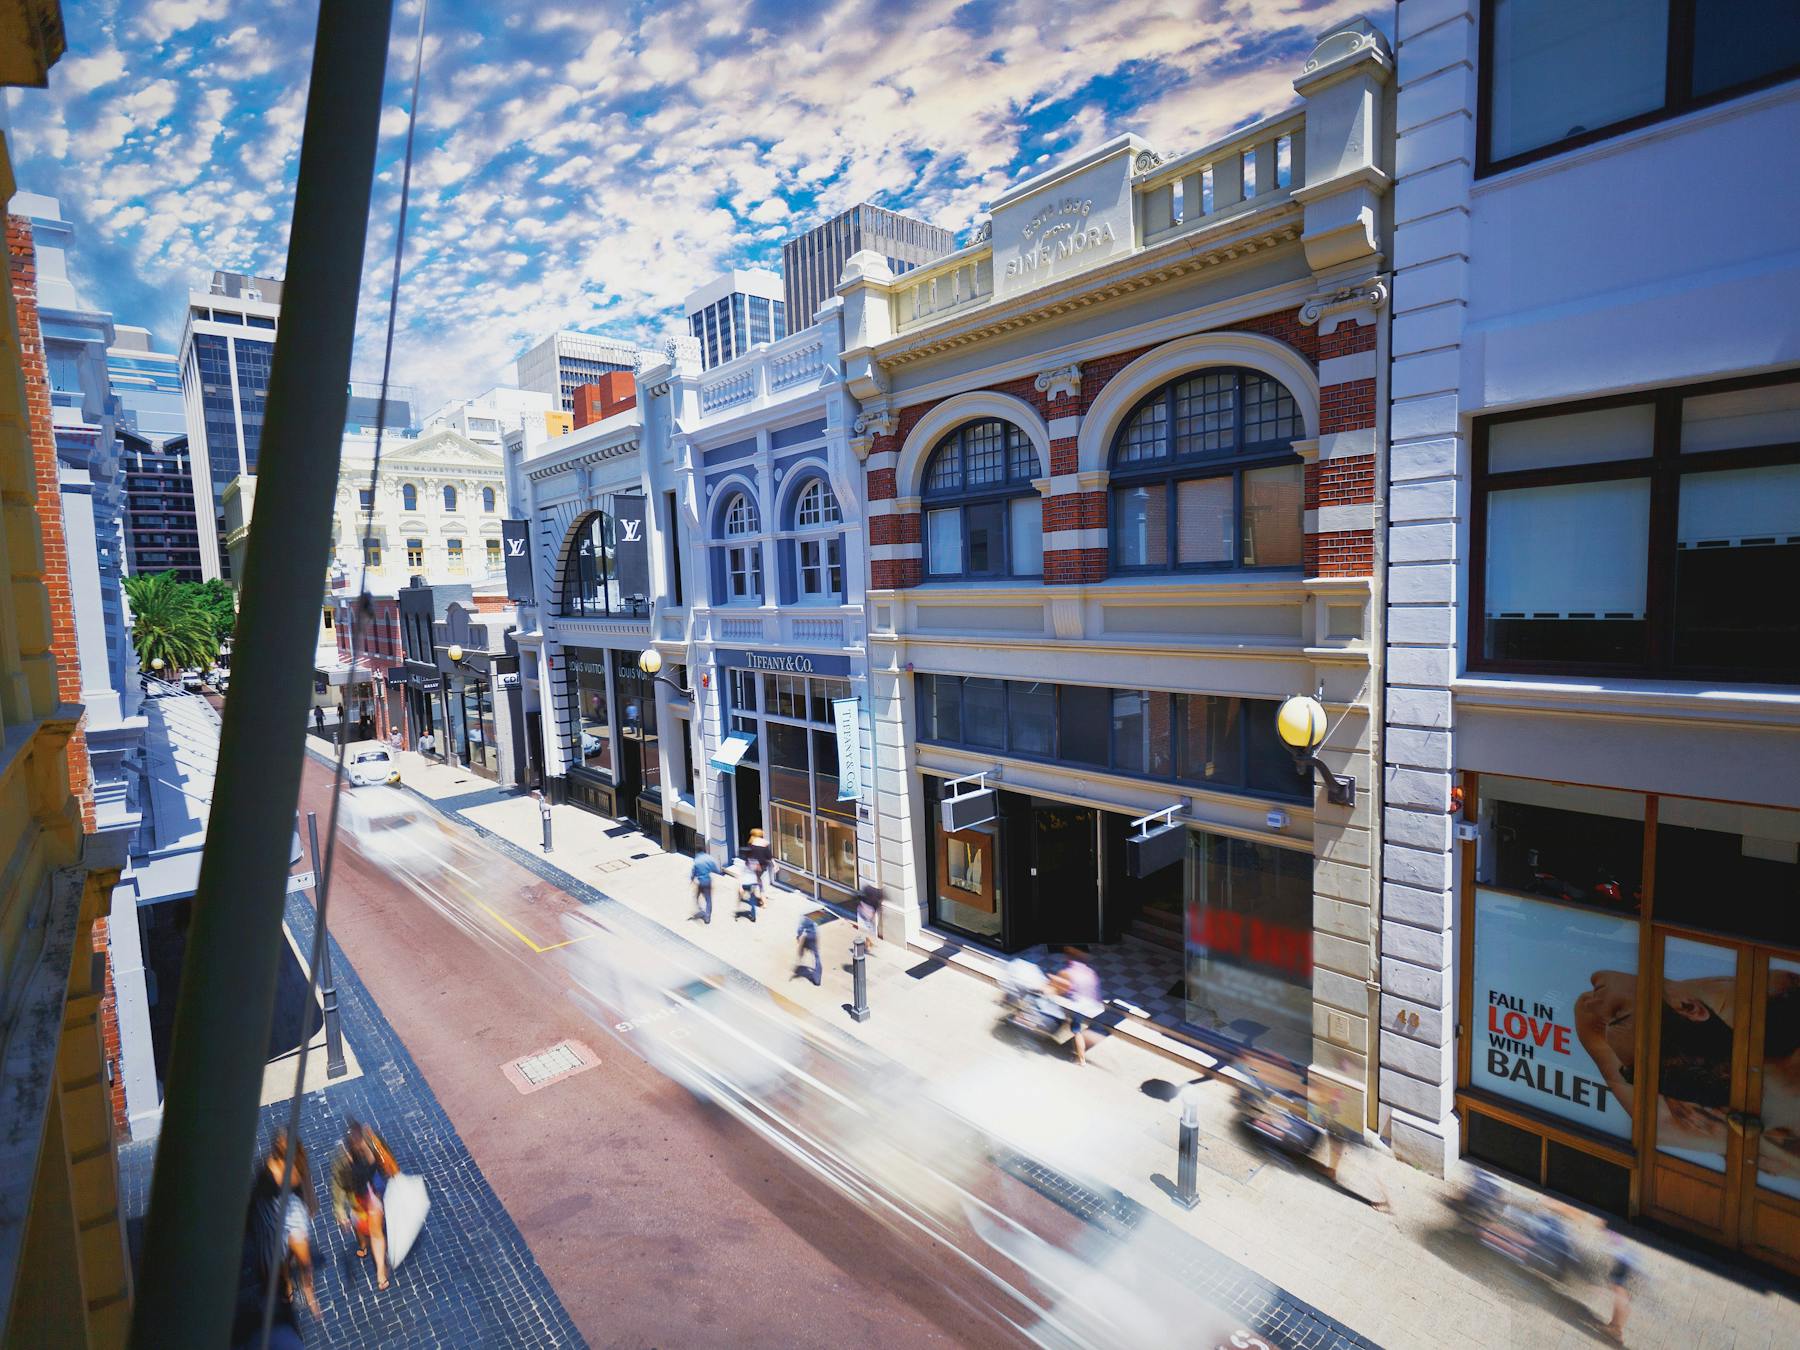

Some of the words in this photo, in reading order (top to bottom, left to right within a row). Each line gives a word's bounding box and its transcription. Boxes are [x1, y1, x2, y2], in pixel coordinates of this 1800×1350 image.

[1006, 246, 1051, 279] SINE
[1058, 222, 1116, 260] MORA
[618, 666, 636, 680] LOUIS
[1489, 990, 1527, 1014] FALL
[1533, 1002, 1553, 1021] IN
[1488, 1006, 1572, 1056] LOVE
[1488, 1033, 1534, 1059] WITH
[1487, 1049, 1612, 1113] BALLET
